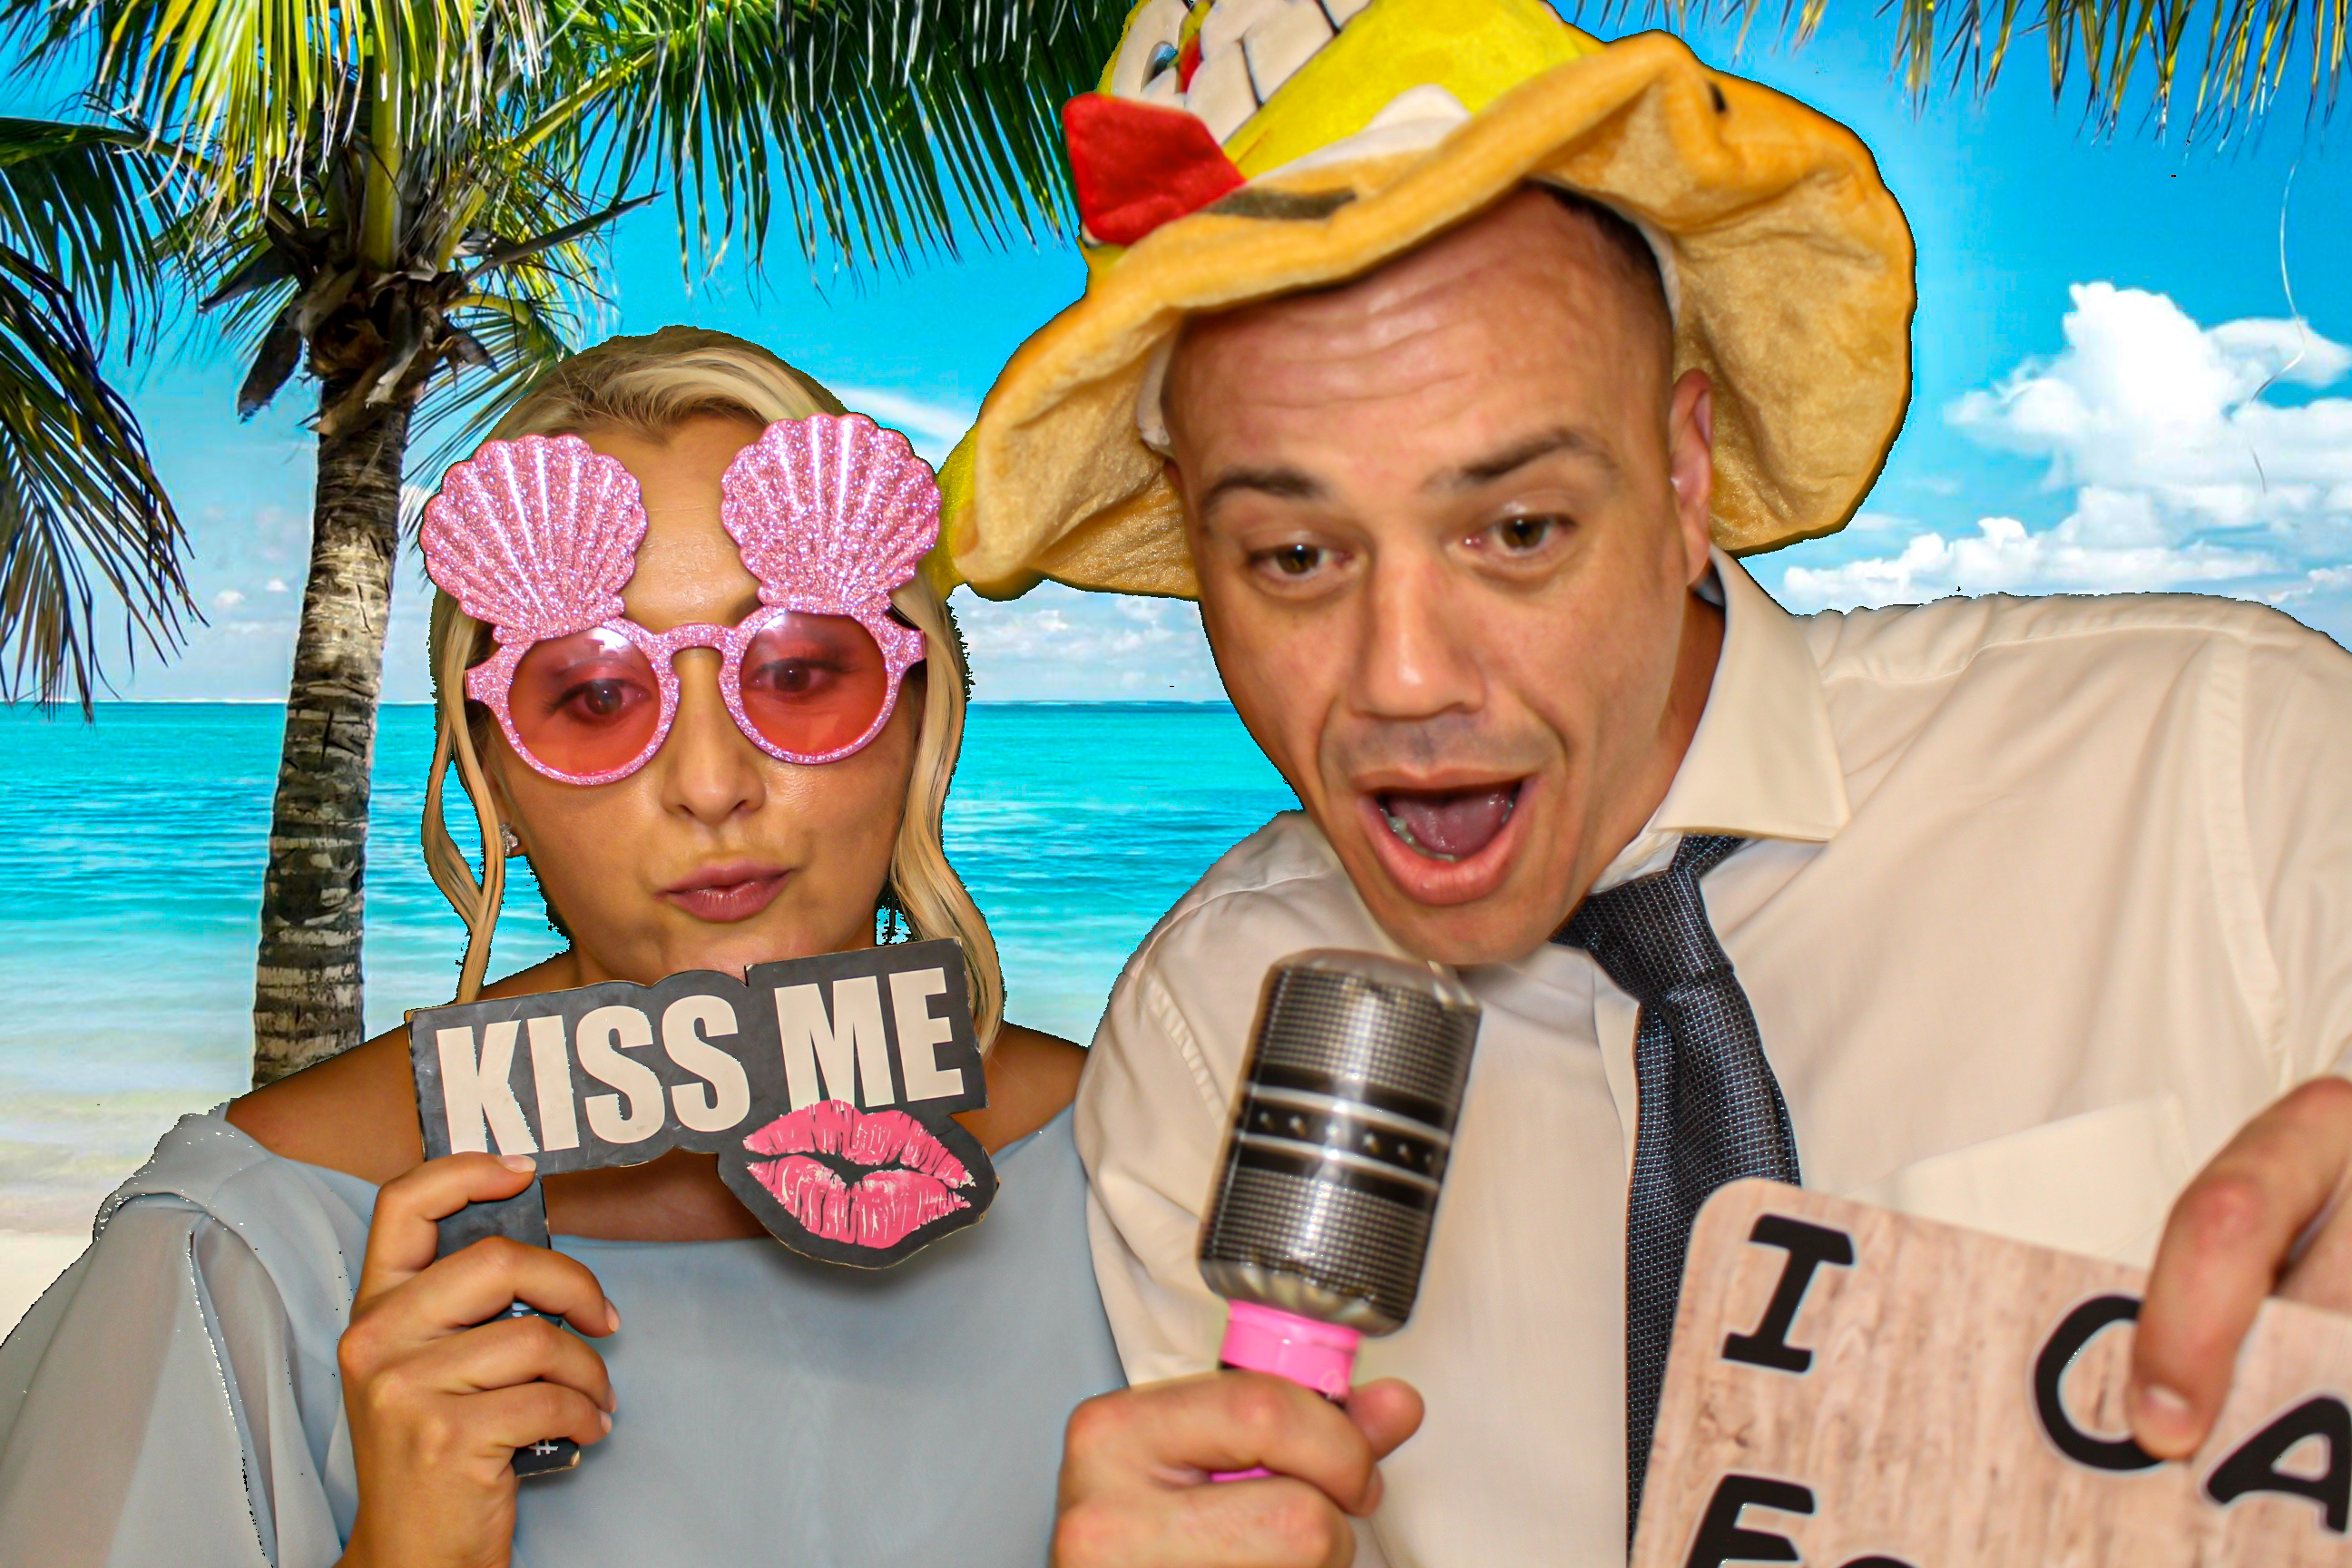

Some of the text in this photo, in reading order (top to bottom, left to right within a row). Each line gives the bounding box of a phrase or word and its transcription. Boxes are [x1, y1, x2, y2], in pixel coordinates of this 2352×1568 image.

[436, 966, 965, 1155] KISS ME
[1721, 1213, 1854, 1374] I
